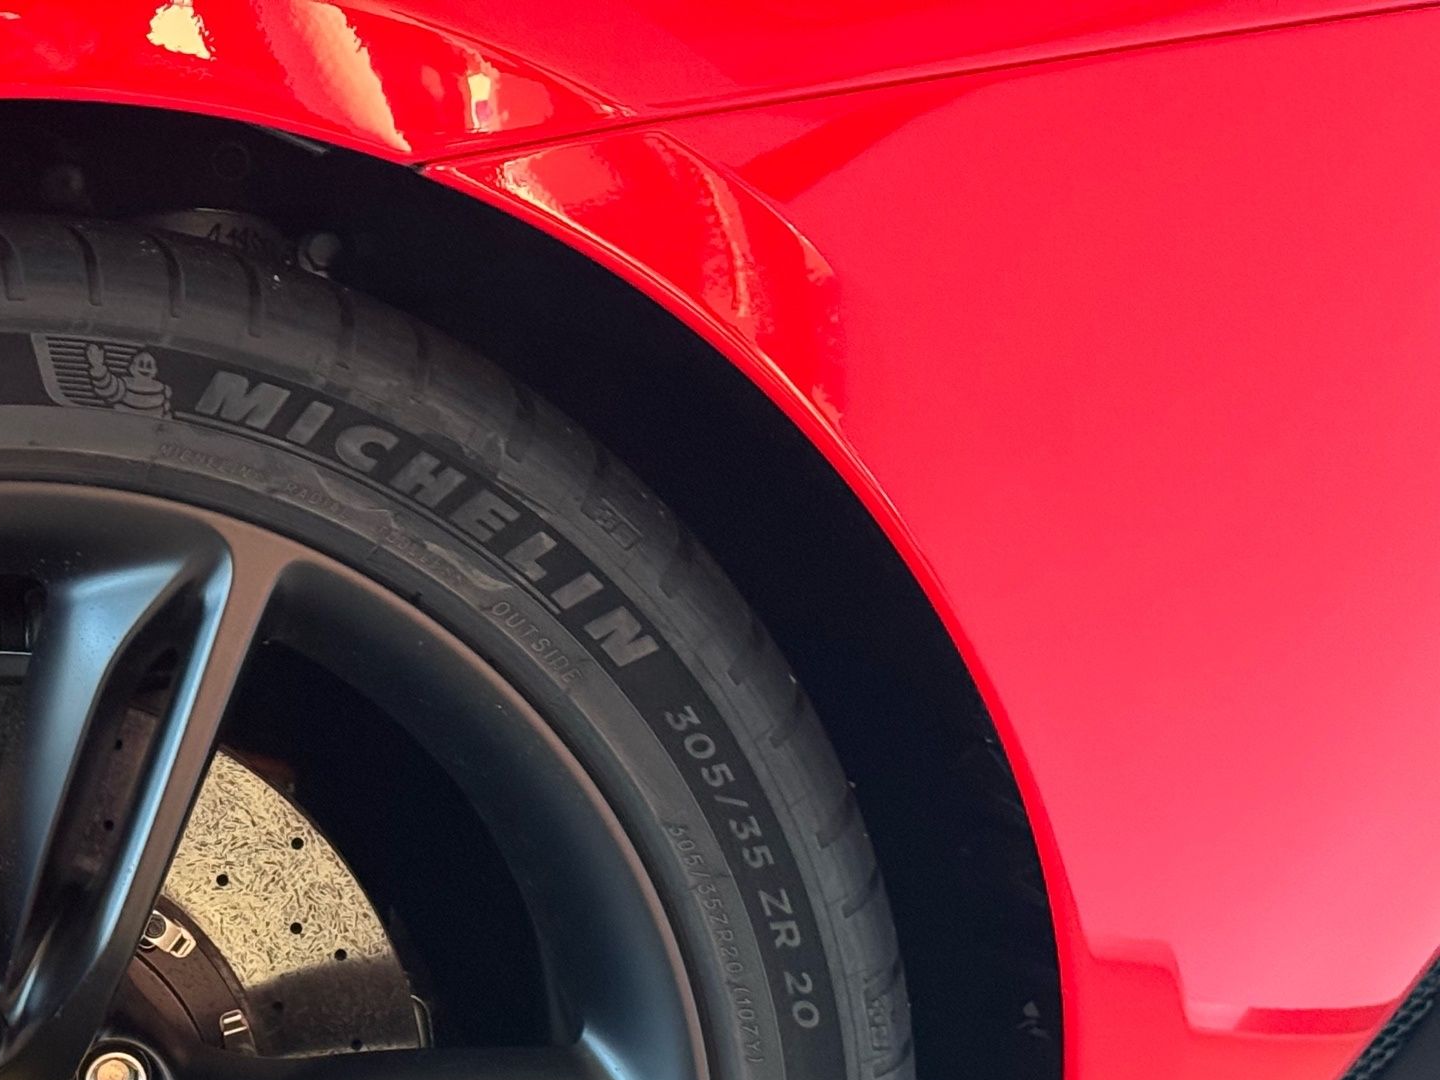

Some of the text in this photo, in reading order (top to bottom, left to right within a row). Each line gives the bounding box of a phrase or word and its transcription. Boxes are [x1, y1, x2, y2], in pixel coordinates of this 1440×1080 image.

[195, 370, 661, 669] MICHELIN
[664, 704, 821, 1028] 305/35 ZR 20
